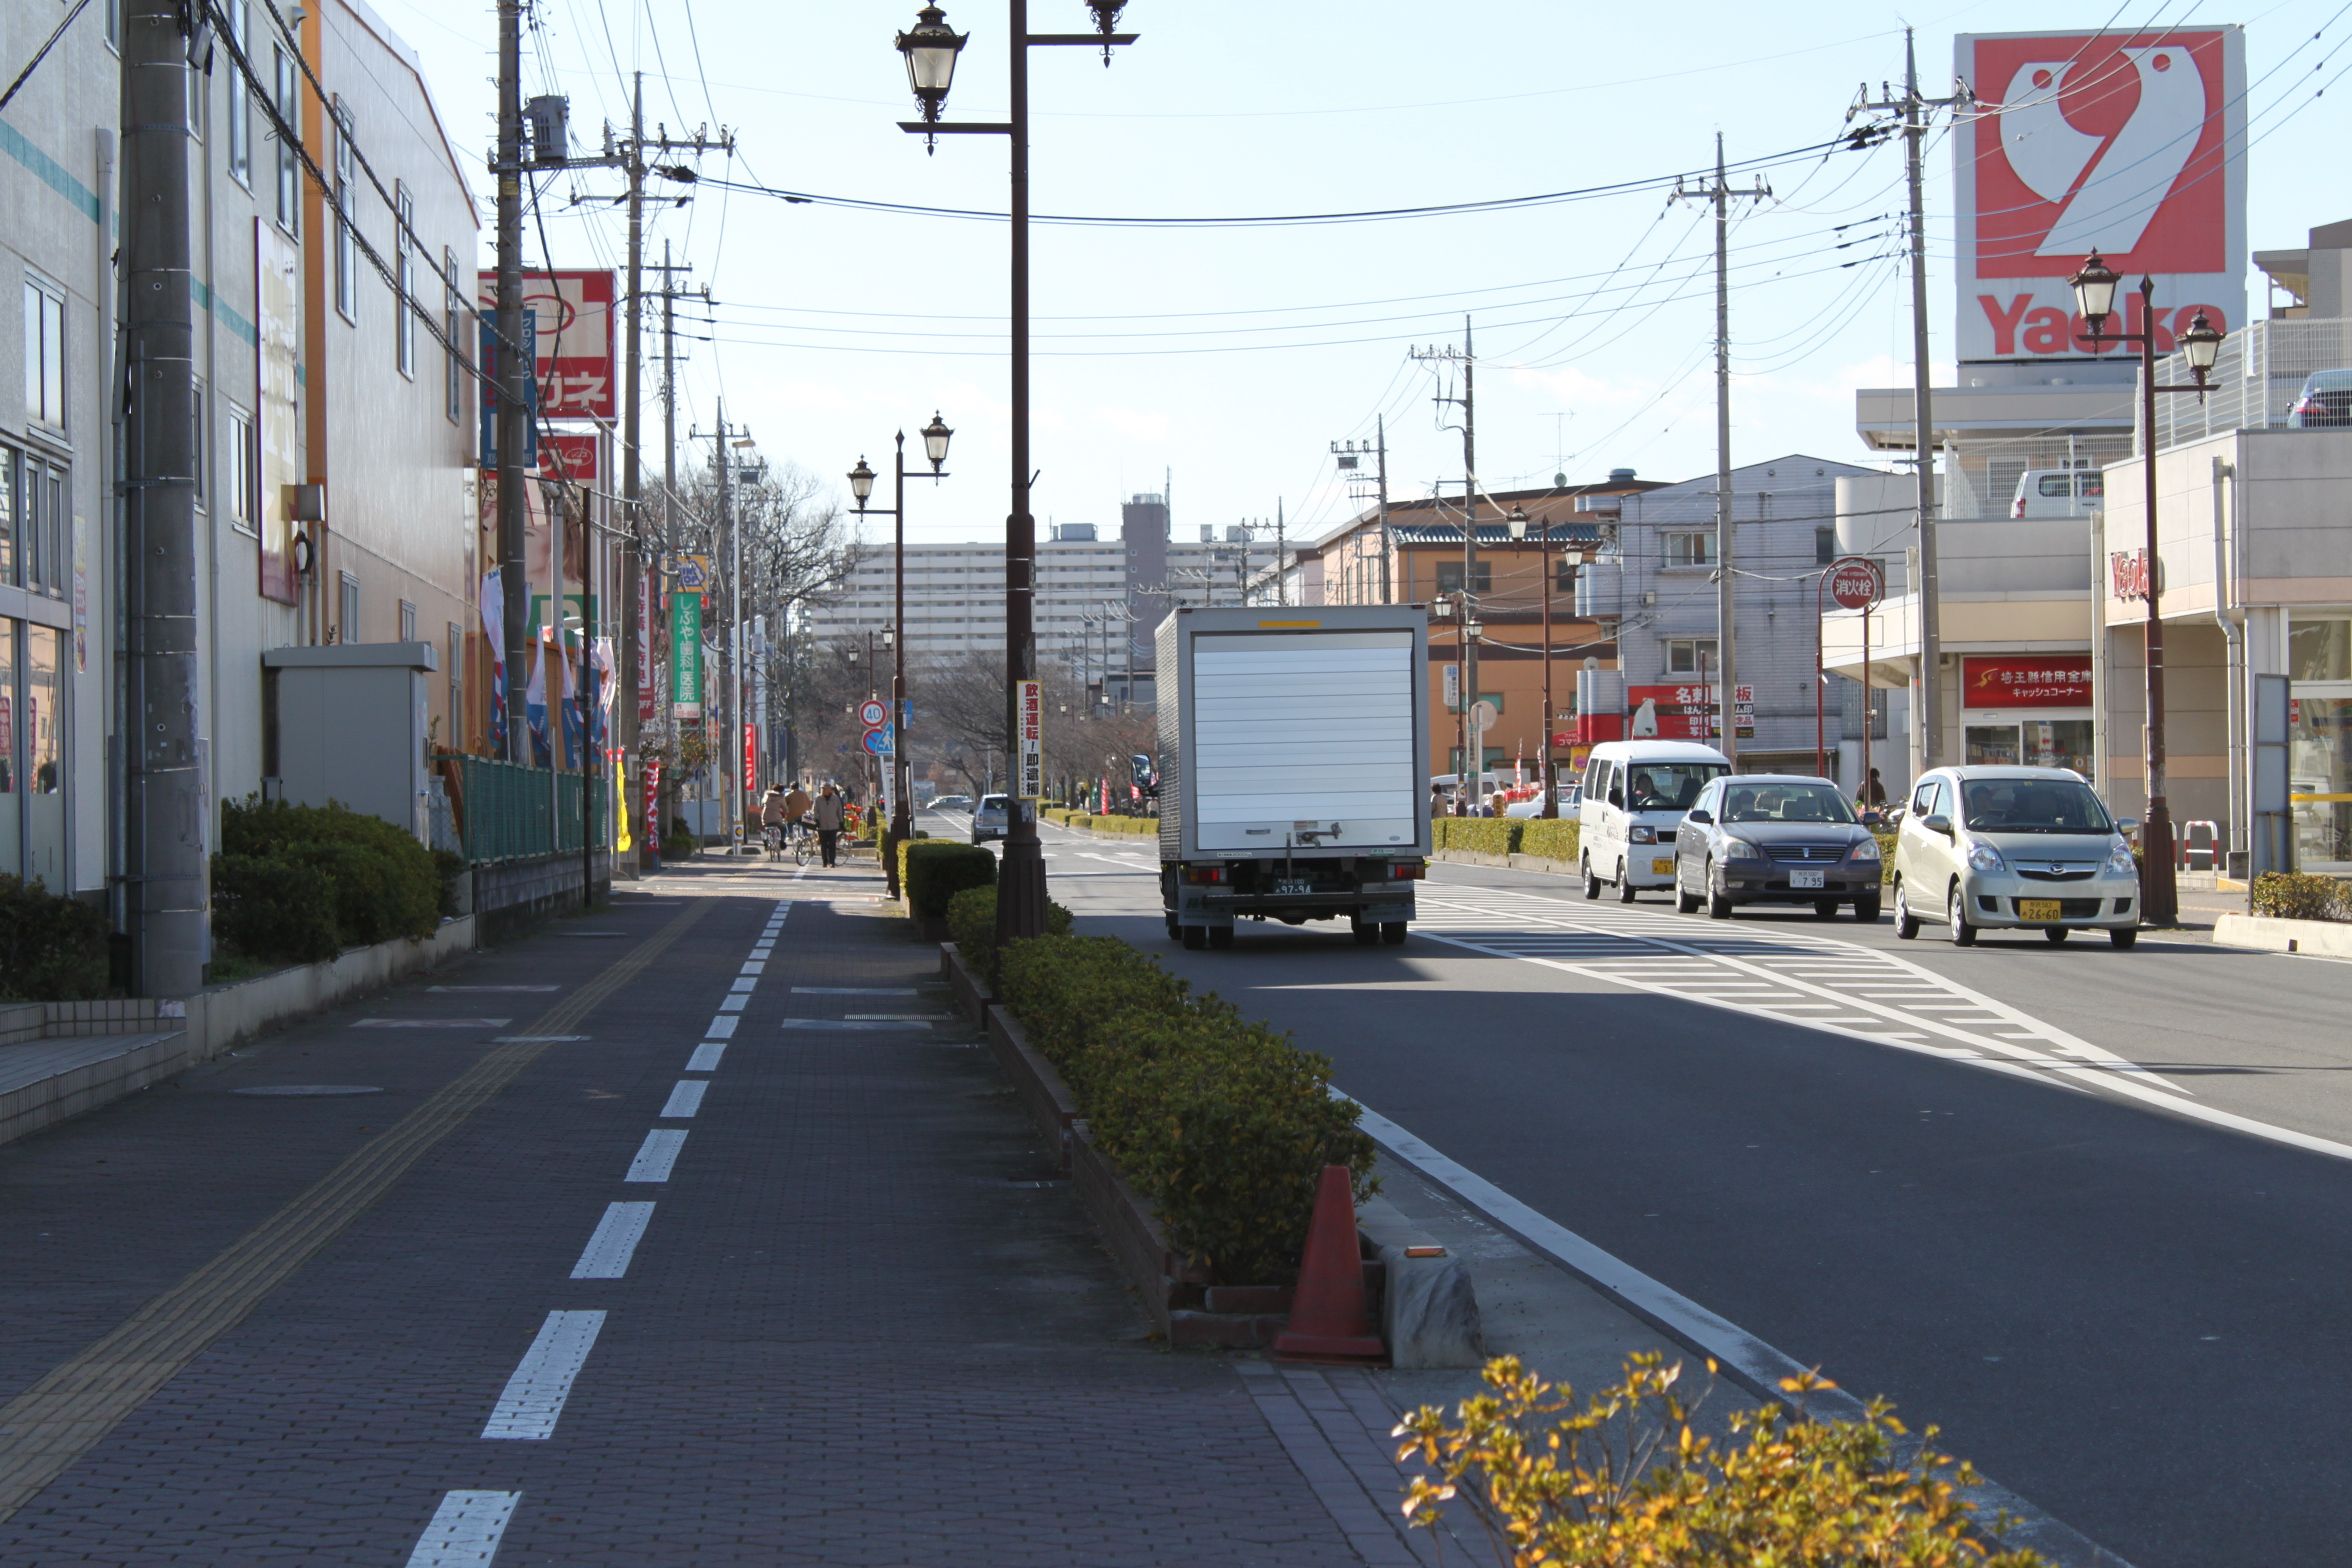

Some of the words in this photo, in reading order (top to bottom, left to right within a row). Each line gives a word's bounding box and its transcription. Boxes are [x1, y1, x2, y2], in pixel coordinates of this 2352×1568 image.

[1836, 579, 1872, 596] 消火栓
[2000, 670, 2093, 685] 埼玉縣信用金庫
[1675, 686, 1709, 704] 名刺
[2012, 687, 2083, 698] キャッシュコーナー
[866, 708, 881, 719] 40
[1683, 705, 1709, 714] はんこ
